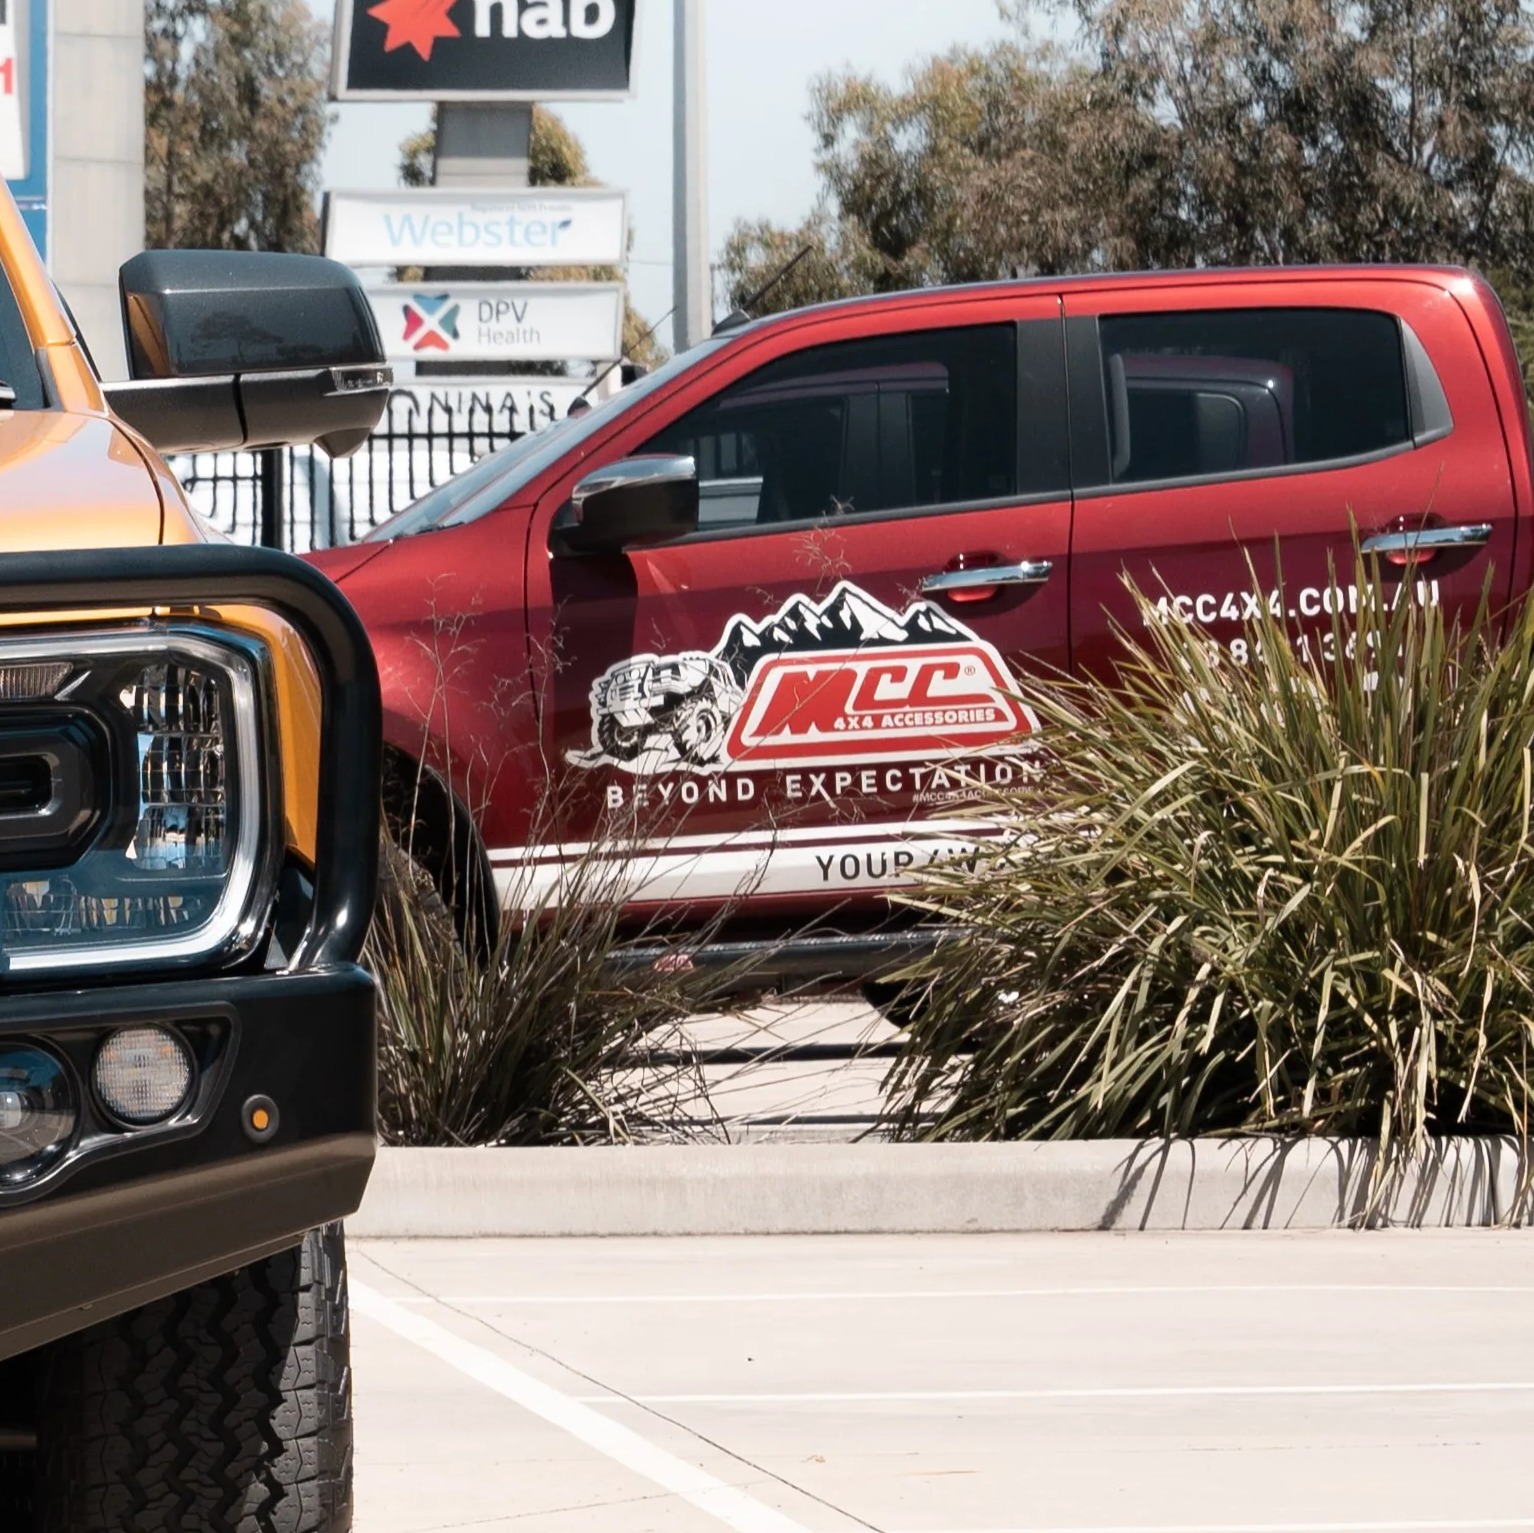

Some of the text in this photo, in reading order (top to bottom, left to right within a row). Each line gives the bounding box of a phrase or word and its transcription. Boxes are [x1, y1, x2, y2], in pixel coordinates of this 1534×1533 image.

[383, 211, 569, 248] Webster
[478, 300, 528, 323] DPV
[478, 327, 541, 345] Health
[748, 662, 996, 737] MCC
[834, 707, 996, 731] 4X4 ACCESSORIES
[606, 778, 755, 808] BEYOND
